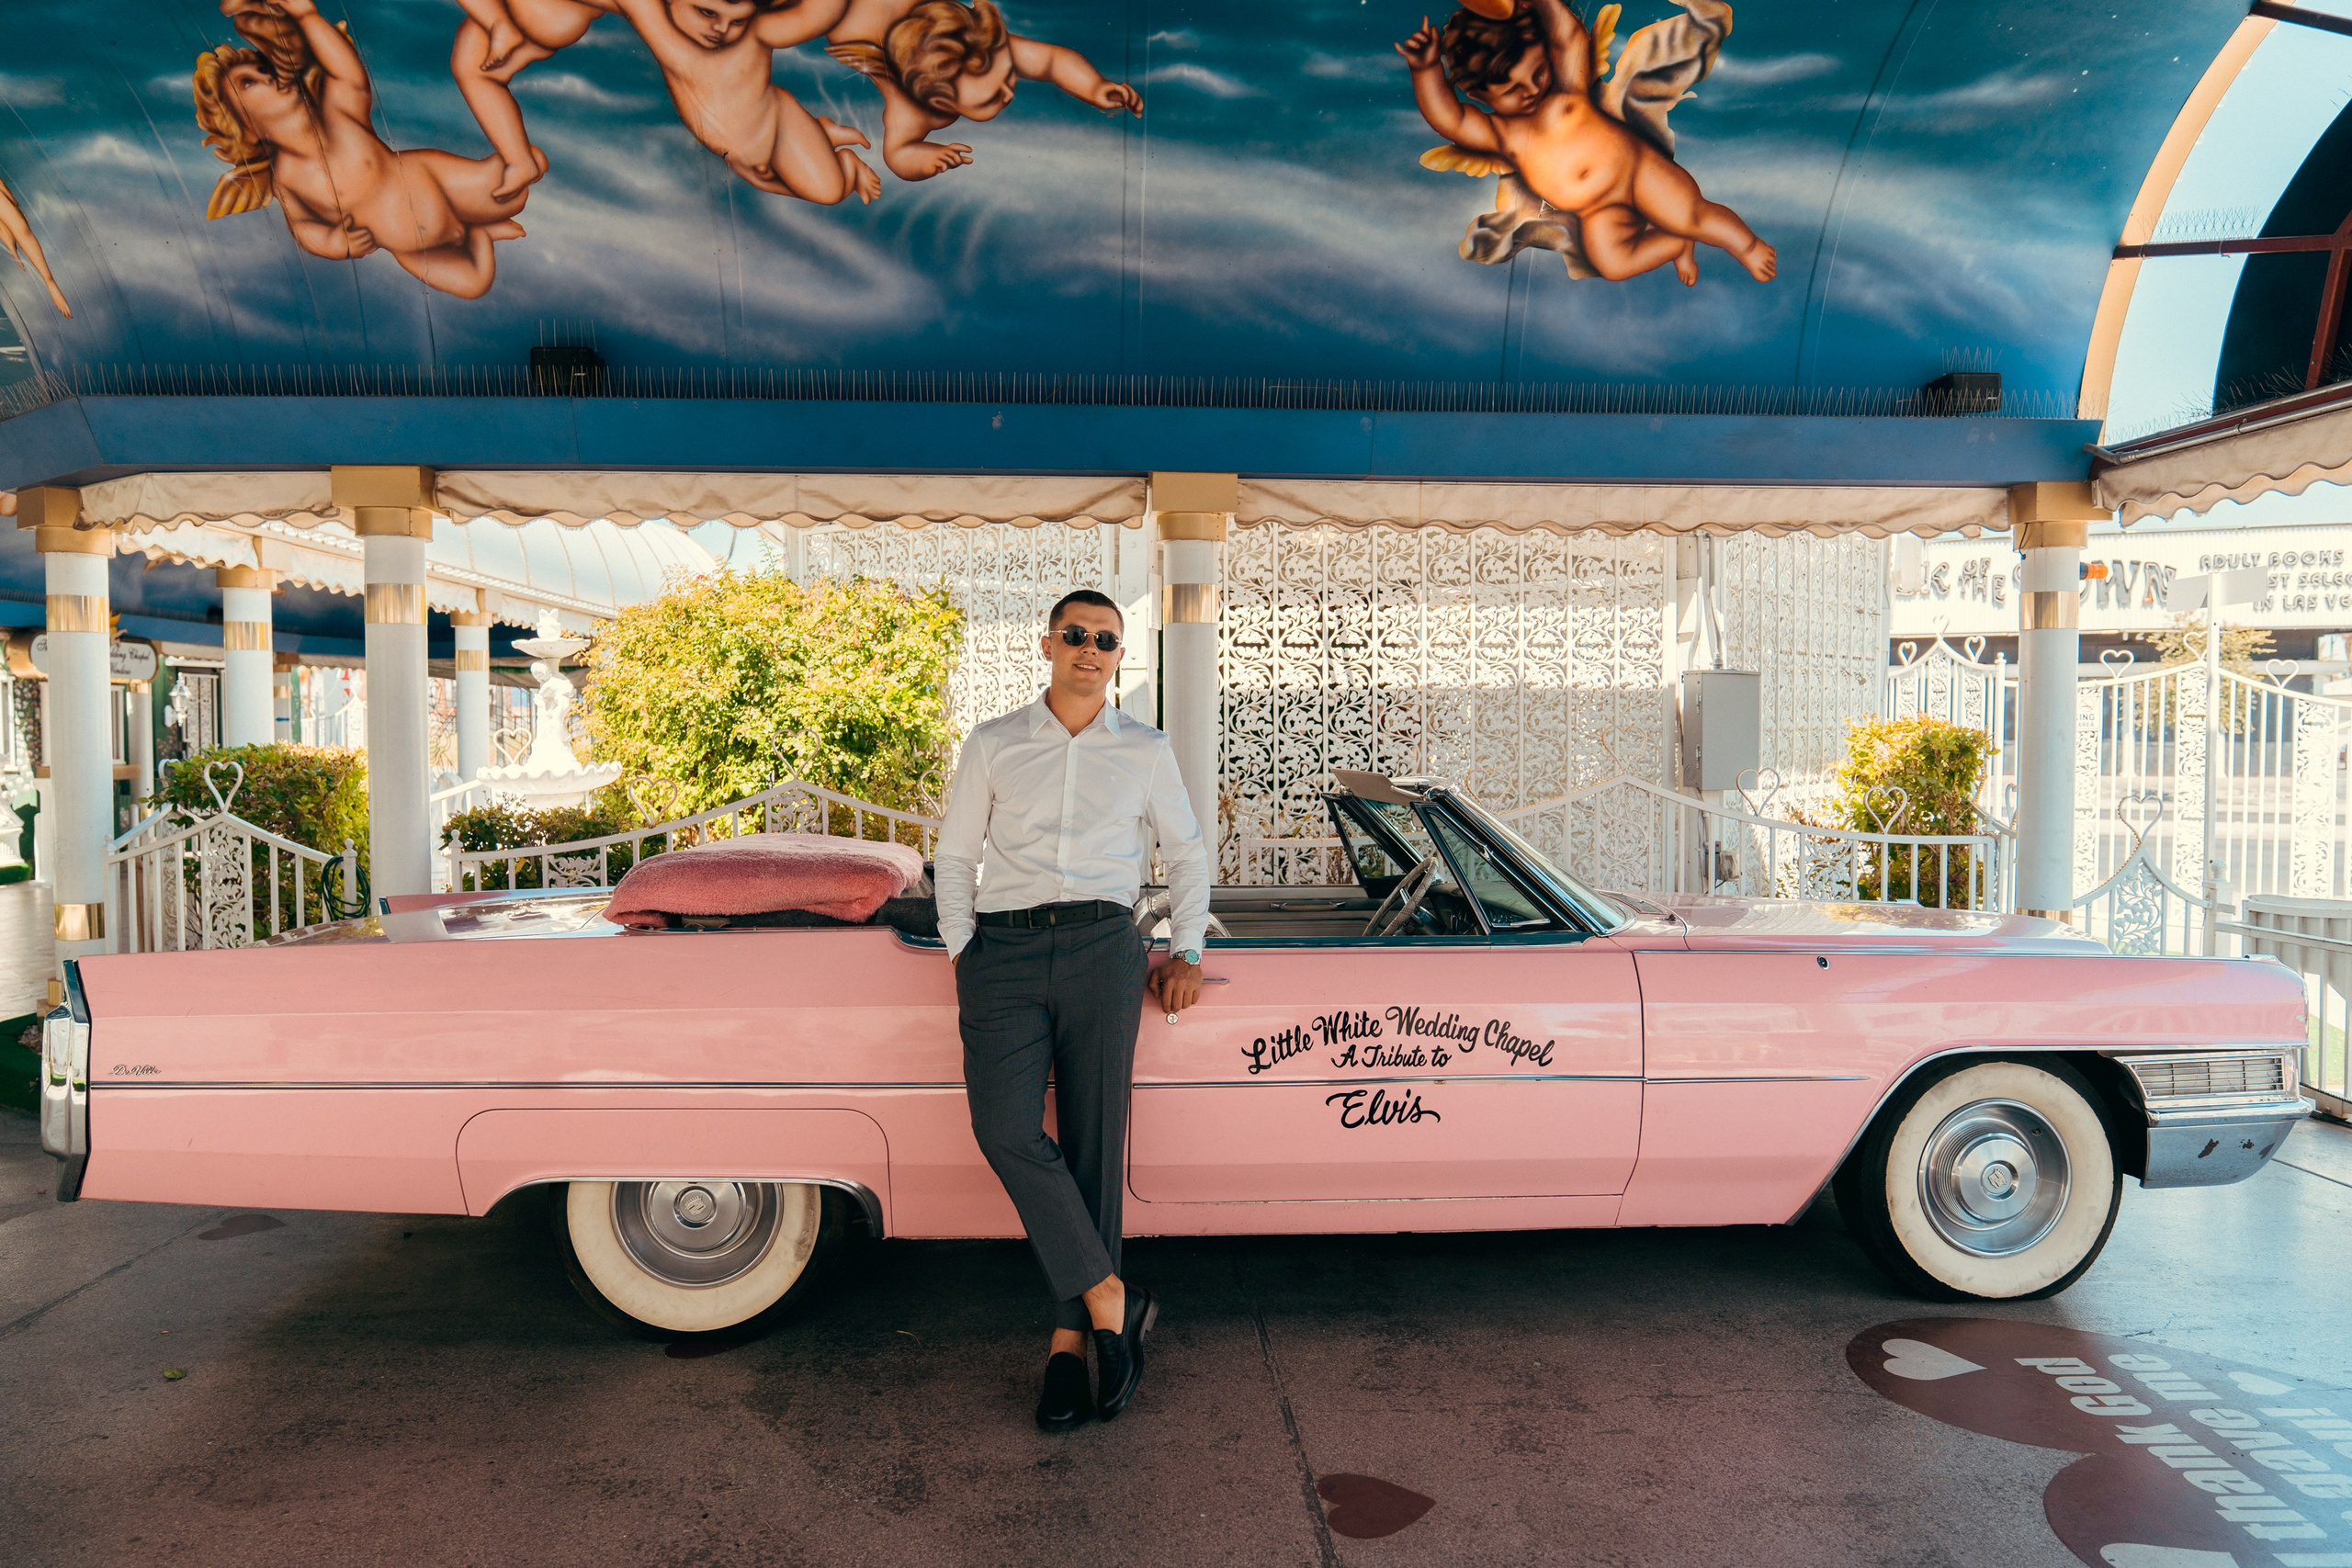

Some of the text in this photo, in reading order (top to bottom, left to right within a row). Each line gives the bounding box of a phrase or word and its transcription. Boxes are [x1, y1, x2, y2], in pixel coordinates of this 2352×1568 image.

[1962, 558, 1992, 576] OF
[2200, 549, 2345, 570] ADULT BOOKS
[1958, 574, 2006, 604] THE
[2268, 572, 2290, 589] ST
[2282, 594, 2318, 611] LAS
[1241, 1006, 1555, 1075] Little White Wedding Chapel
[1331, 1043, 1453, 1068] A Tribute to
[1325, 1088, 1442, 1129] Elvis
[2013, 1357, 2153, 1416] God
[2108, 1353, 2223, 1401] me
[2115, 1423, 2328, 1542] thank
